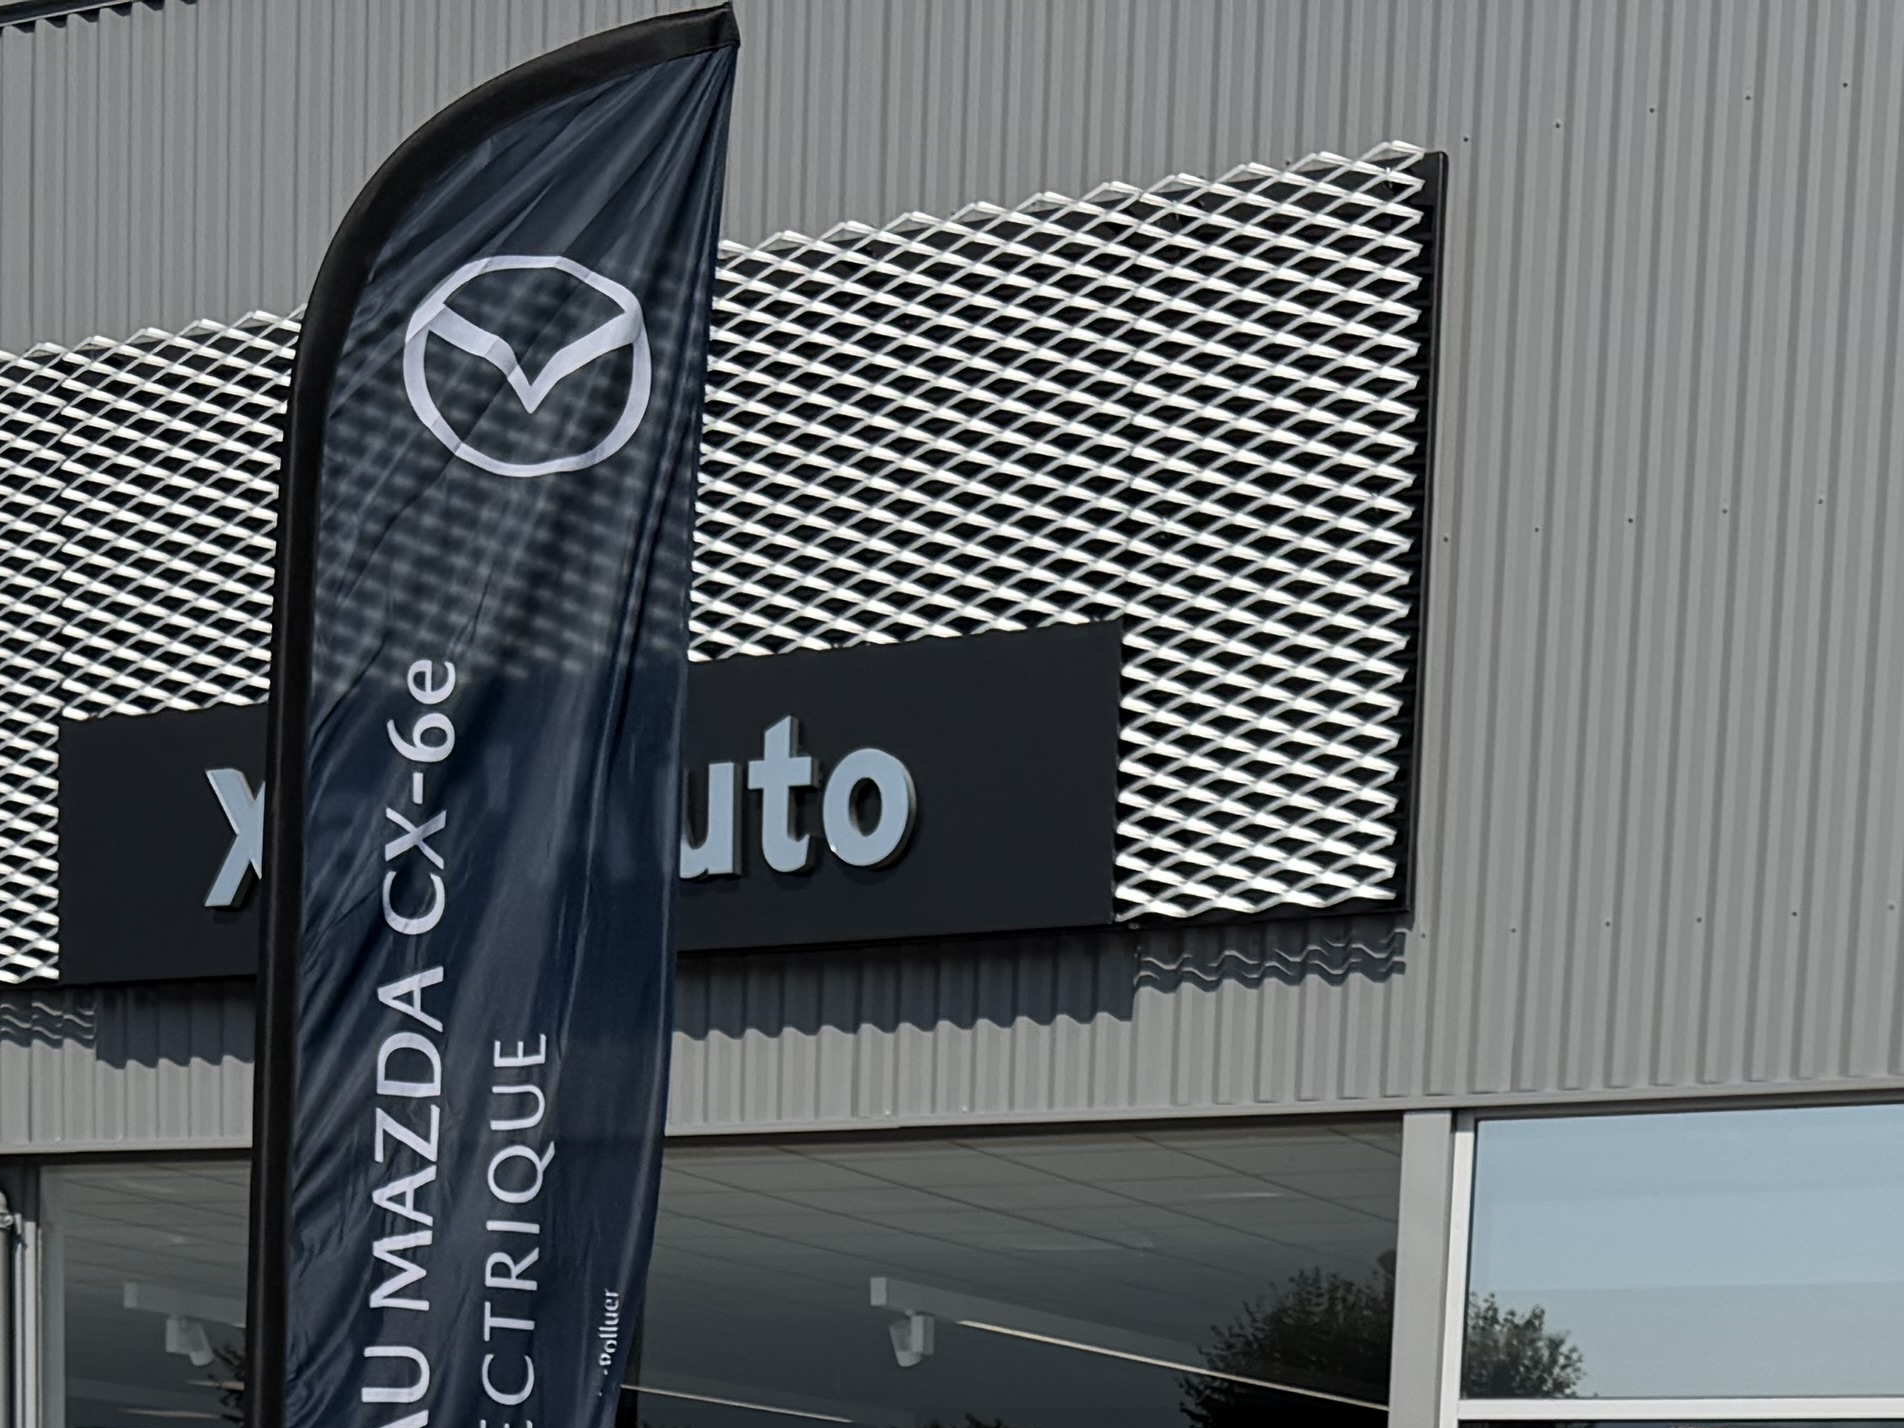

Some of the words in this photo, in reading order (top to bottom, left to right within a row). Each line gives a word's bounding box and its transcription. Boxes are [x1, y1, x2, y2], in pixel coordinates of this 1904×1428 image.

[382, 659, 456, 936] CX-6e
[680, 714, 916, 879] uto
[368, 963, 445, 1311] MAZDA
